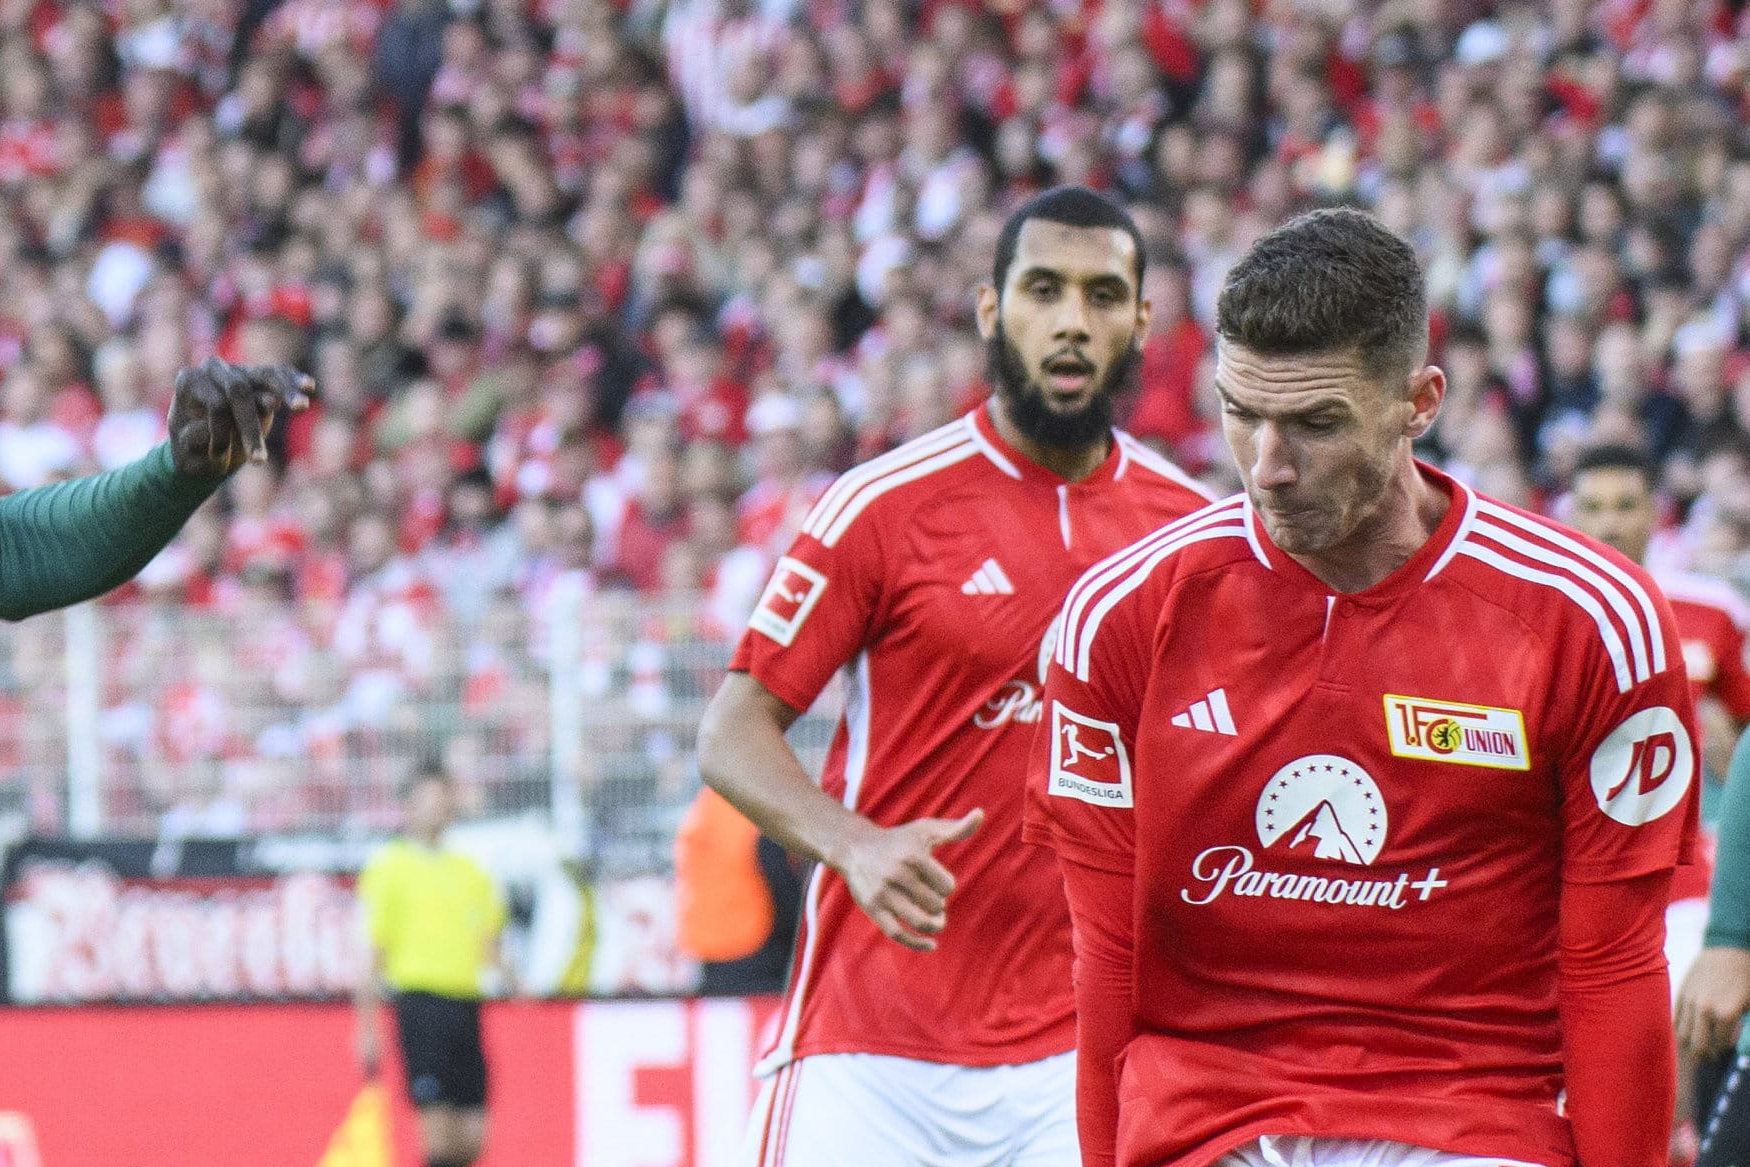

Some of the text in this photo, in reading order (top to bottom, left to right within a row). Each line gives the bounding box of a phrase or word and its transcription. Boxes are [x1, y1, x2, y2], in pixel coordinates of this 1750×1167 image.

[1464, 728, 1516, 756] UNION
[1605, 731, 1676, 802] JD
[1058, 777, 1124, 800] BUNDESLIGA
